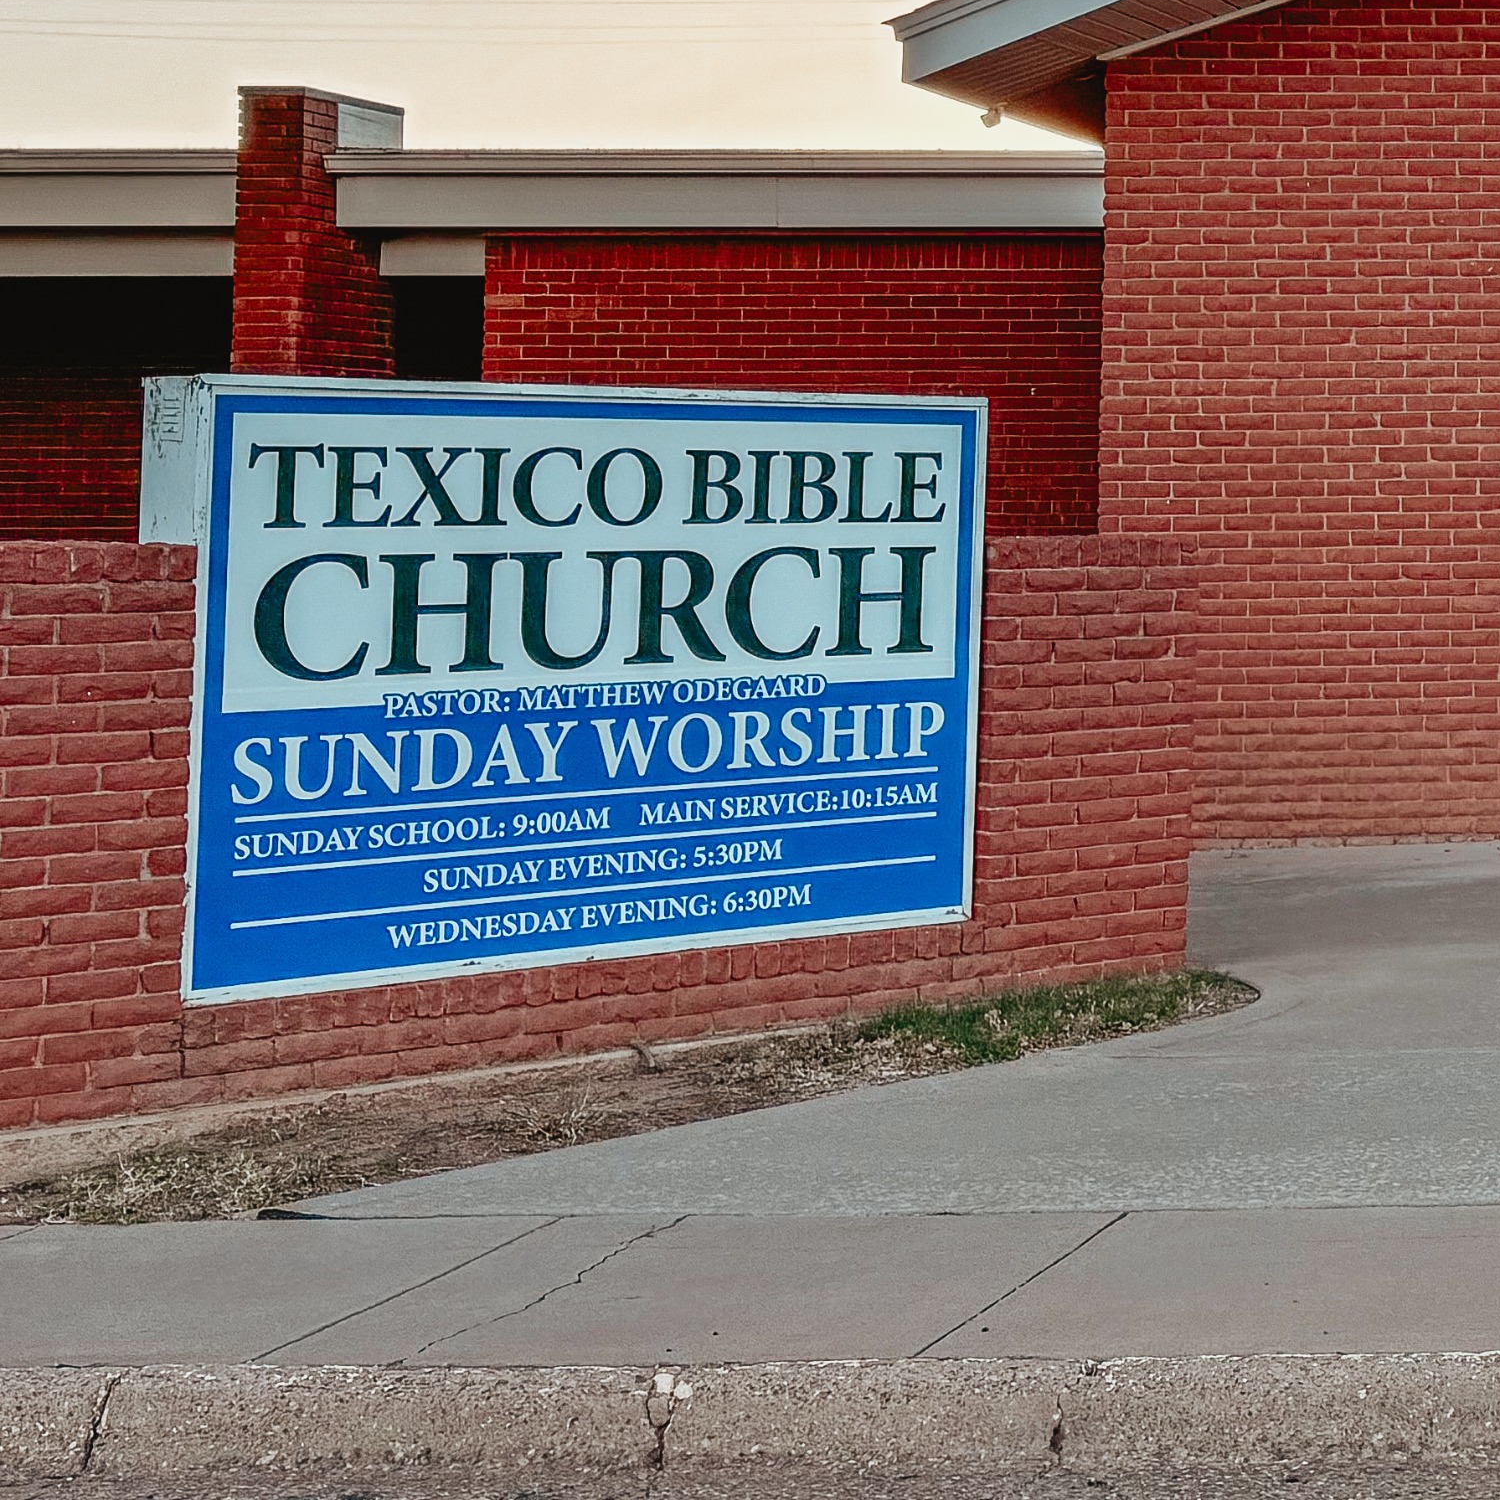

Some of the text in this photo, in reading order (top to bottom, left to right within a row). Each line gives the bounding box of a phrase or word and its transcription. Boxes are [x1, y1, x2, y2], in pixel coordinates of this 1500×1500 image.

[249, 442, 947, 529] TEXICO BIBLE
[253, 545, 936, 681] CHURCH
[384, 674, 826, 718] PASTOR: MATTHEW ODEGAARD
[231, 701, 946, 805] SUNDAY WORSHIP
[234, 826, 363, 860] SUNDAY
[368, 815, 506, 849] SCHOOL:
[513, 807, 611, 836] 9:00AM
[639, 798, 716, 826] MAIN
[423, 838, 783, 893] SUNDAY EVENING: 5:30PM
[387, 883, 812, 949] WEDNESDAY EVENING: 6:30PM
